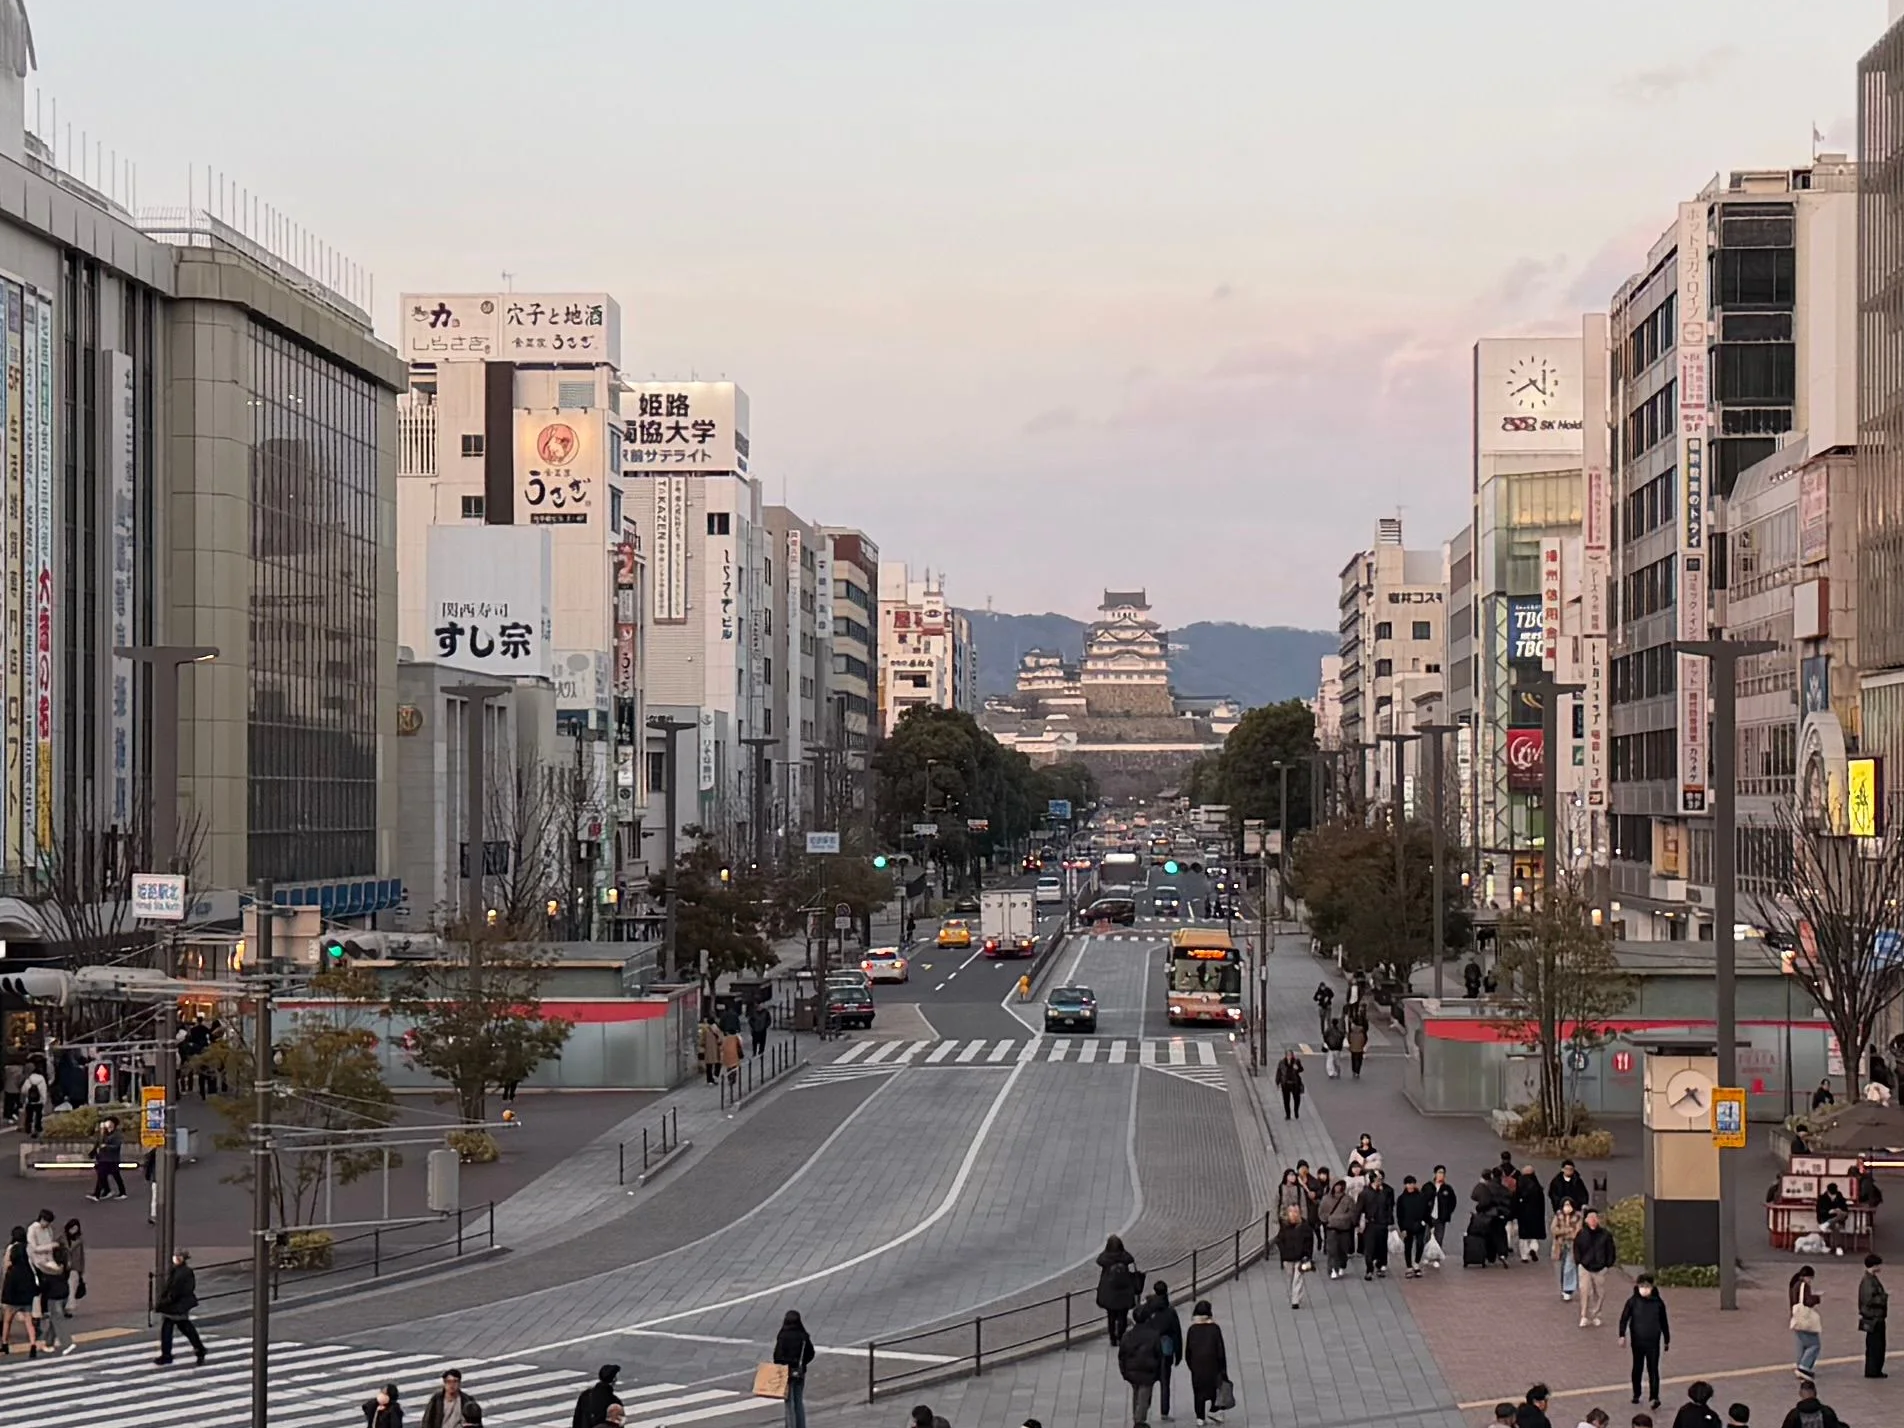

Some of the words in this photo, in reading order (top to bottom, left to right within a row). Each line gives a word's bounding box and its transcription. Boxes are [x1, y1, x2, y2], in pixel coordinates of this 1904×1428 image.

[506, 302, 603, 327] 穴子と地酒
[638, 392, 690, 418] 姫路
[434, 620, 533, 660] すし宗
